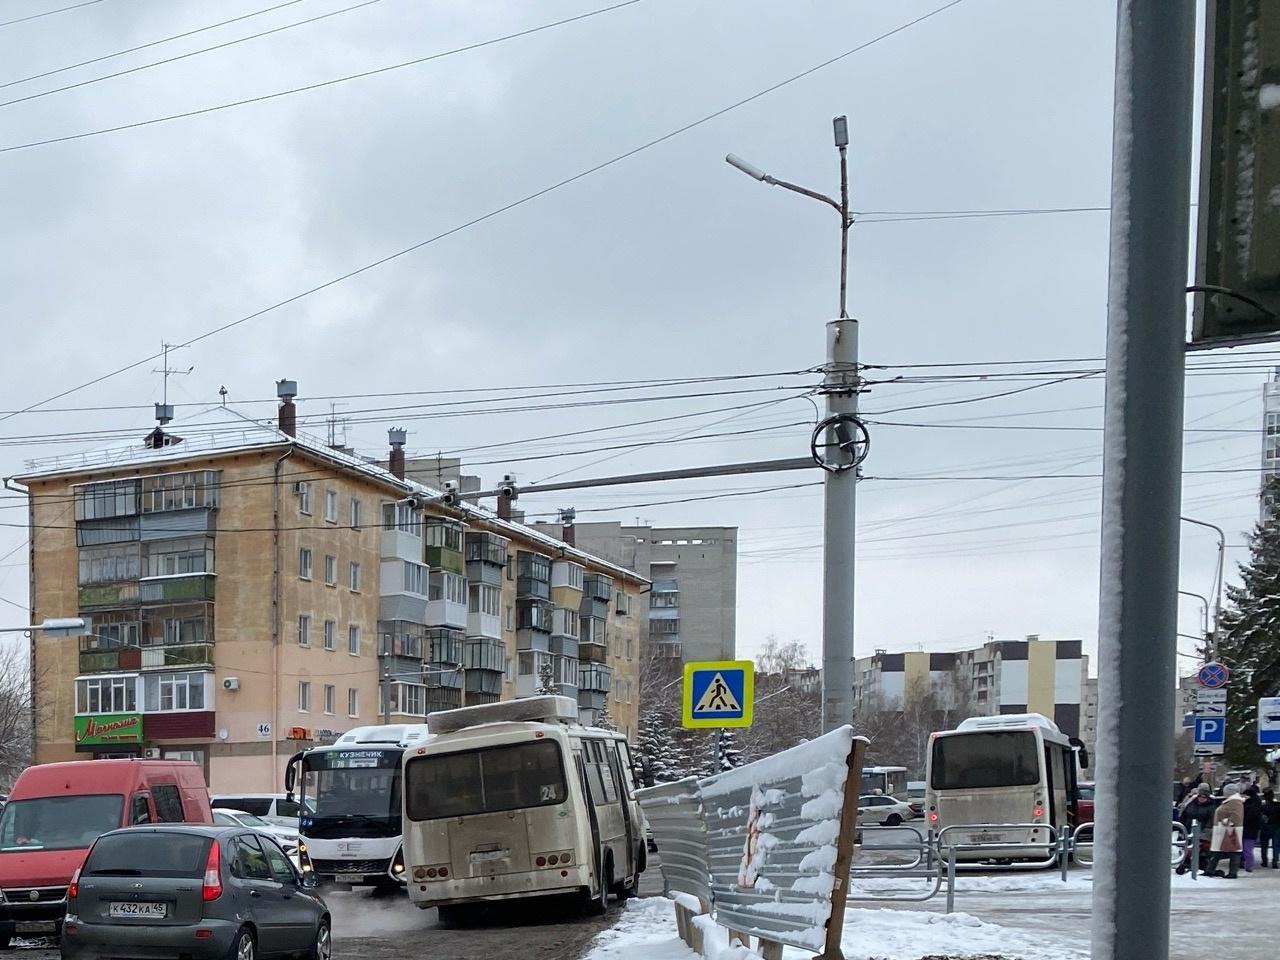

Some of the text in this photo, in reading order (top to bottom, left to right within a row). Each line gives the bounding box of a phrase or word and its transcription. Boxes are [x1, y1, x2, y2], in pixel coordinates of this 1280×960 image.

[258, 724, 270, 733] 46
[1201, 720, 1218, 741] P
[542, 786, 557, 801] 24
